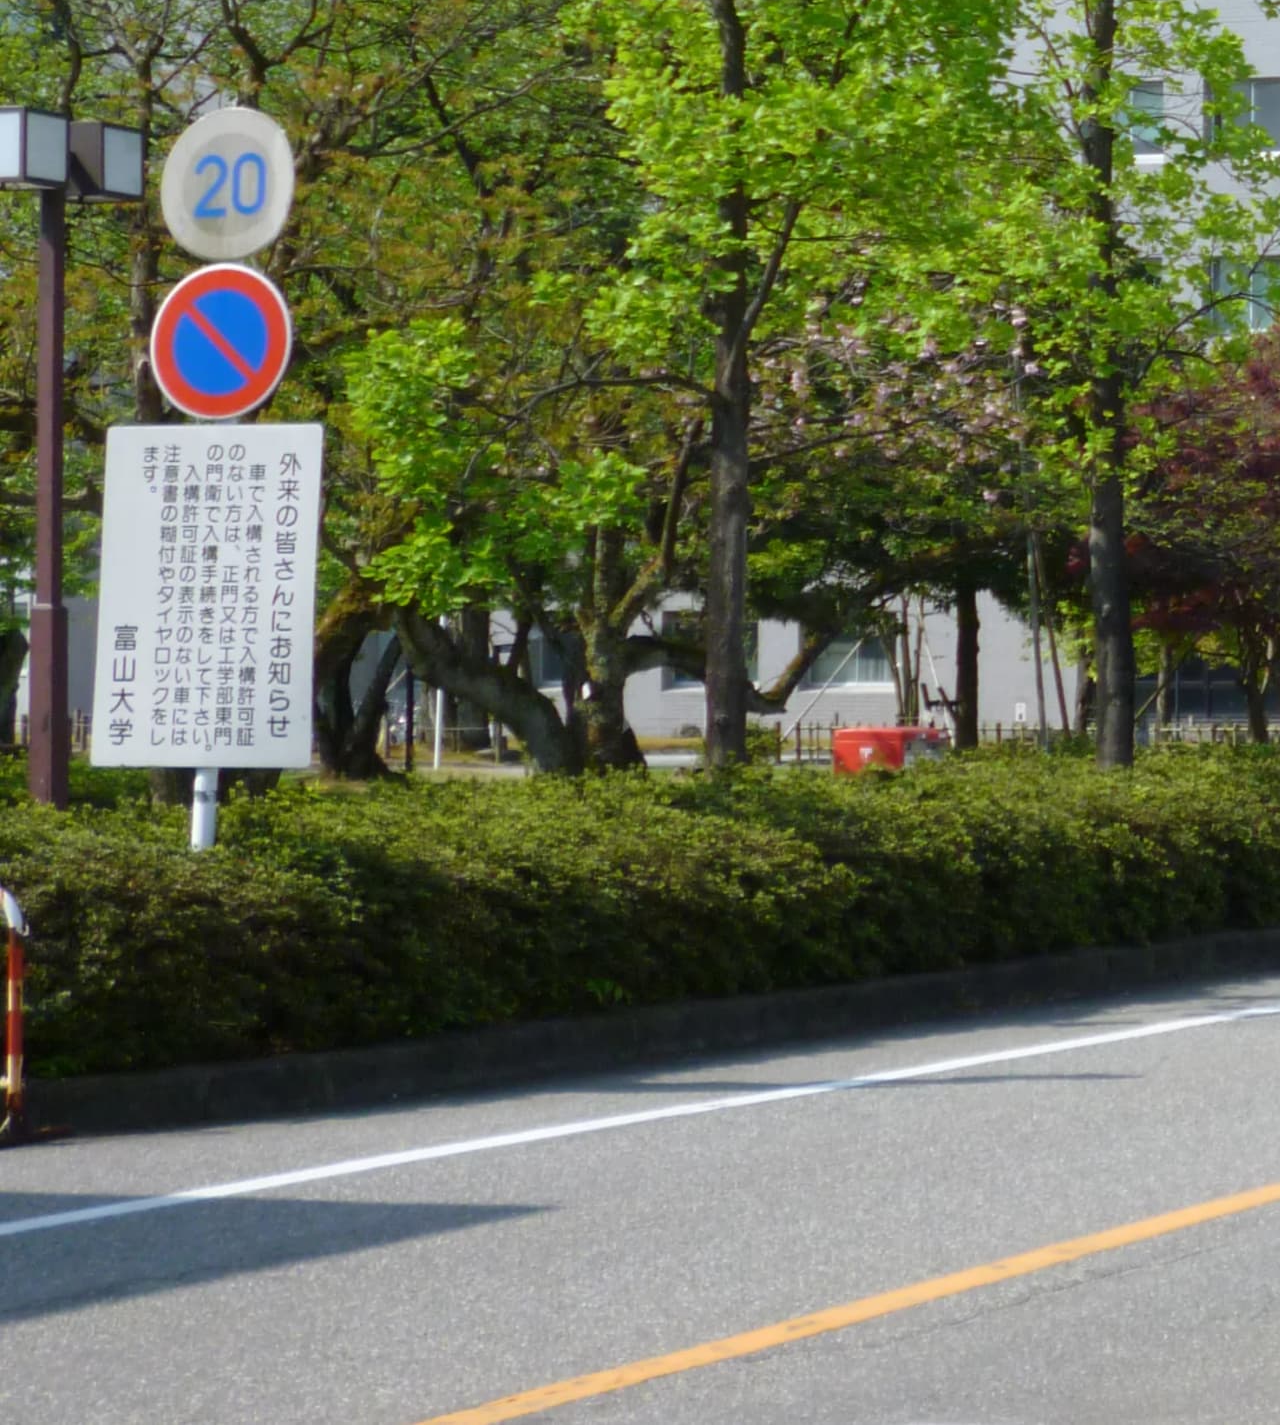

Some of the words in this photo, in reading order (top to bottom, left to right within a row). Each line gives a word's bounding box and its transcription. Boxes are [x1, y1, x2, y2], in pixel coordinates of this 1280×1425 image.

[193, 152, 267, 219] 20
[142, 446, 160, 493] ます。
[171, 465, 201, 746] 入構許可証の表示のない車には
[192, 443, 224, 752] の門衛で入構手続きをして下さい。
[237, 464, 267, 746] 車で入構される方で入構許可証
[267, 453, 302, 738] 外来の皆さんにお知らせ
[109, 625, 139, 746] 富山大学
